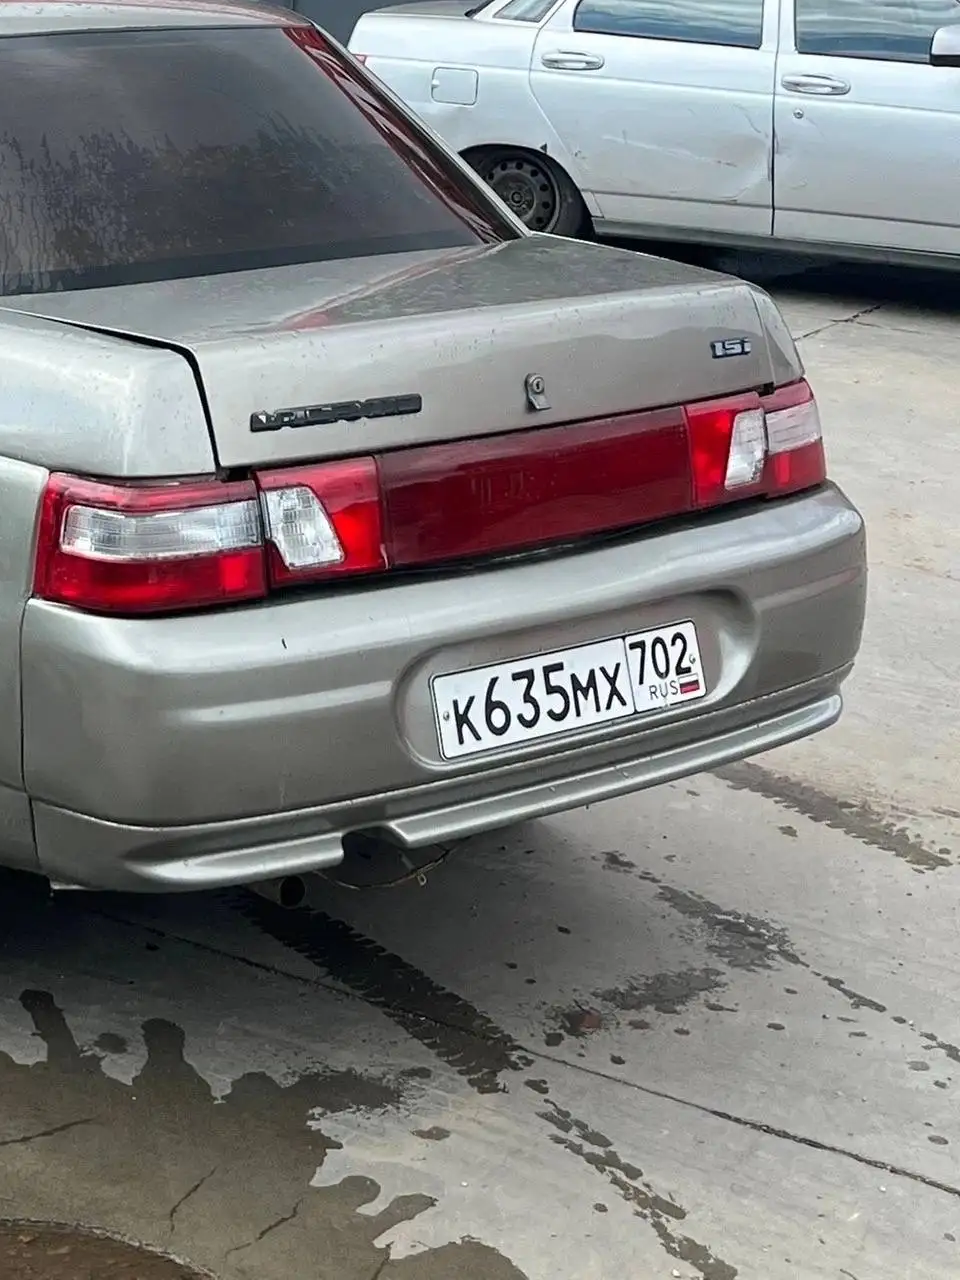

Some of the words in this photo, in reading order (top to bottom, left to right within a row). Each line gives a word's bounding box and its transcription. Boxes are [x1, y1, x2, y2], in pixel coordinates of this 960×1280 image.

[452, 662, 627, 745] К635МХ
[628, 632, 691, 685] 702
[650, 682, 679, 700] RUS
